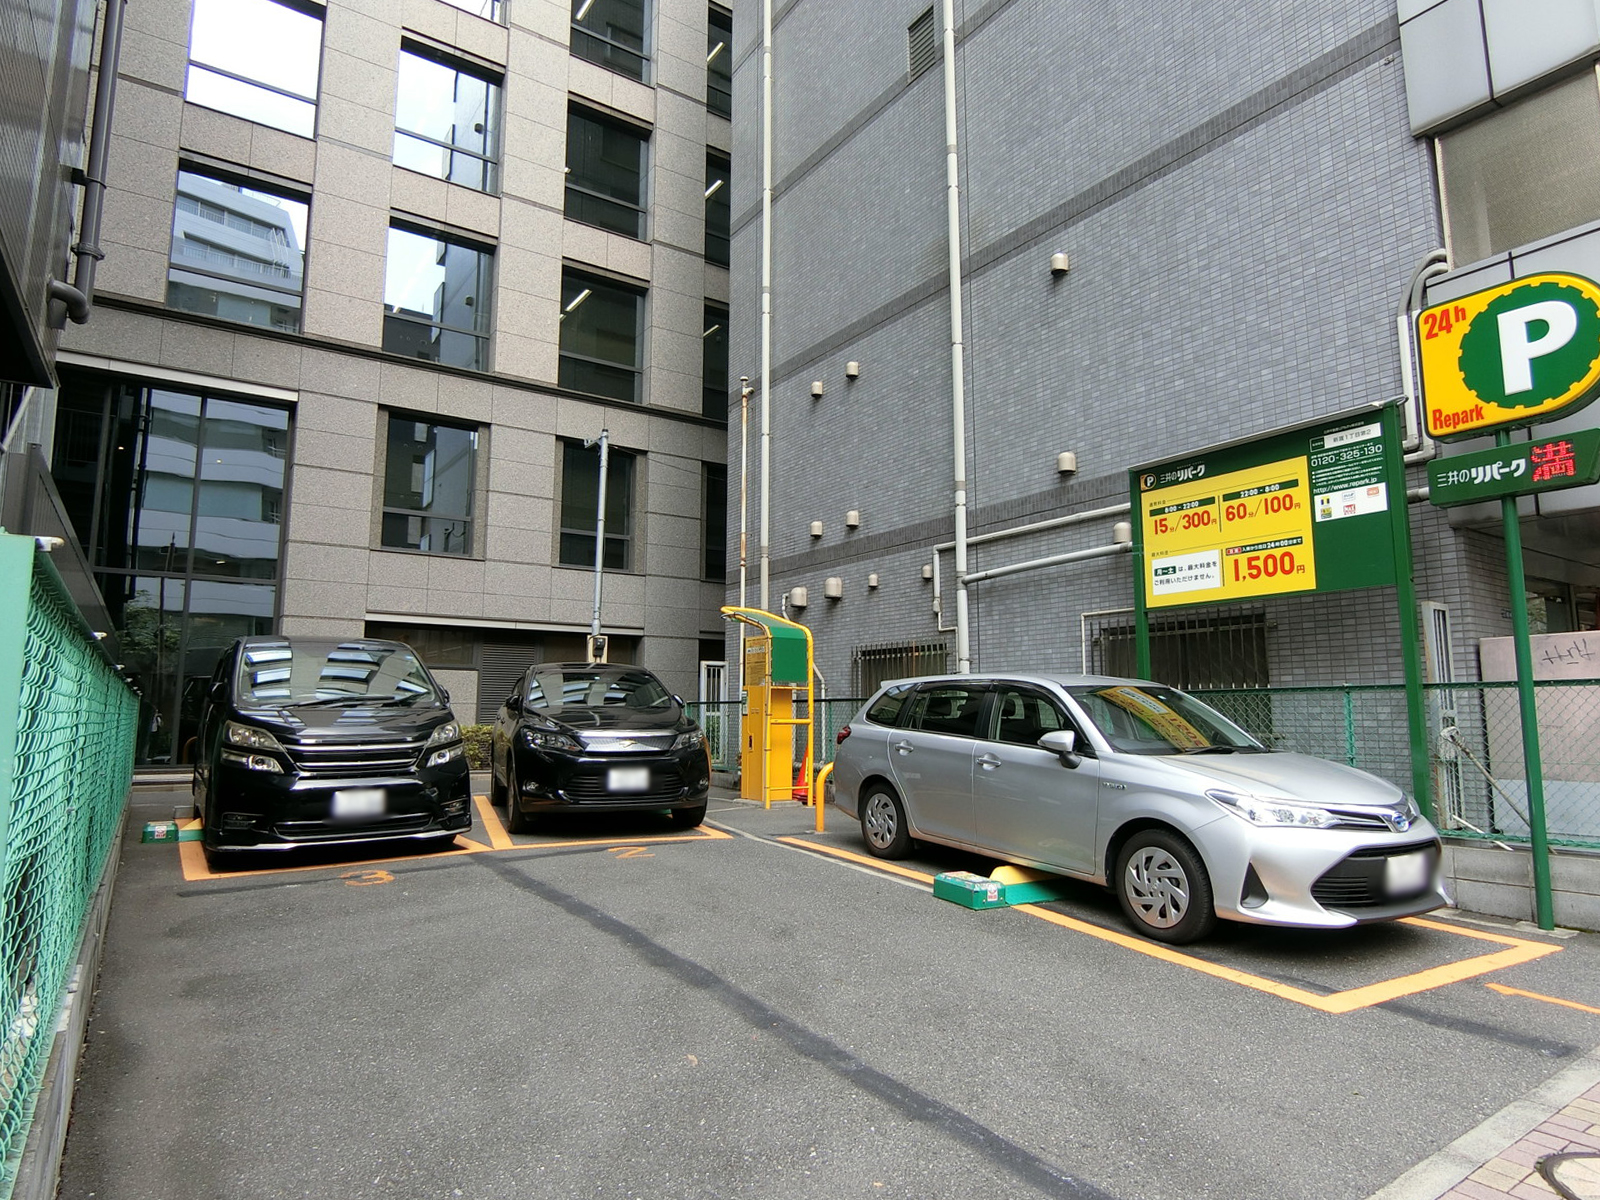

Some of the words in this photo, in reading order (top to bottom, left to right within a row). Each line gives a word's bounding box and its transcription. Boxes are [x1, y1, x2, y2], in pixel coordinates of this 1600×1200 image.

[1497, 300, 1578, 396] P
[1432, 404, 1484, 431] Repark
[1311, 444, 1383, 467] 0120-325-130
[1531, 441, 1577, 482] 満
[1437, 458, 1526, 487] 三井のリパーク
[1234, 551, 1305, 582] 1,500円
